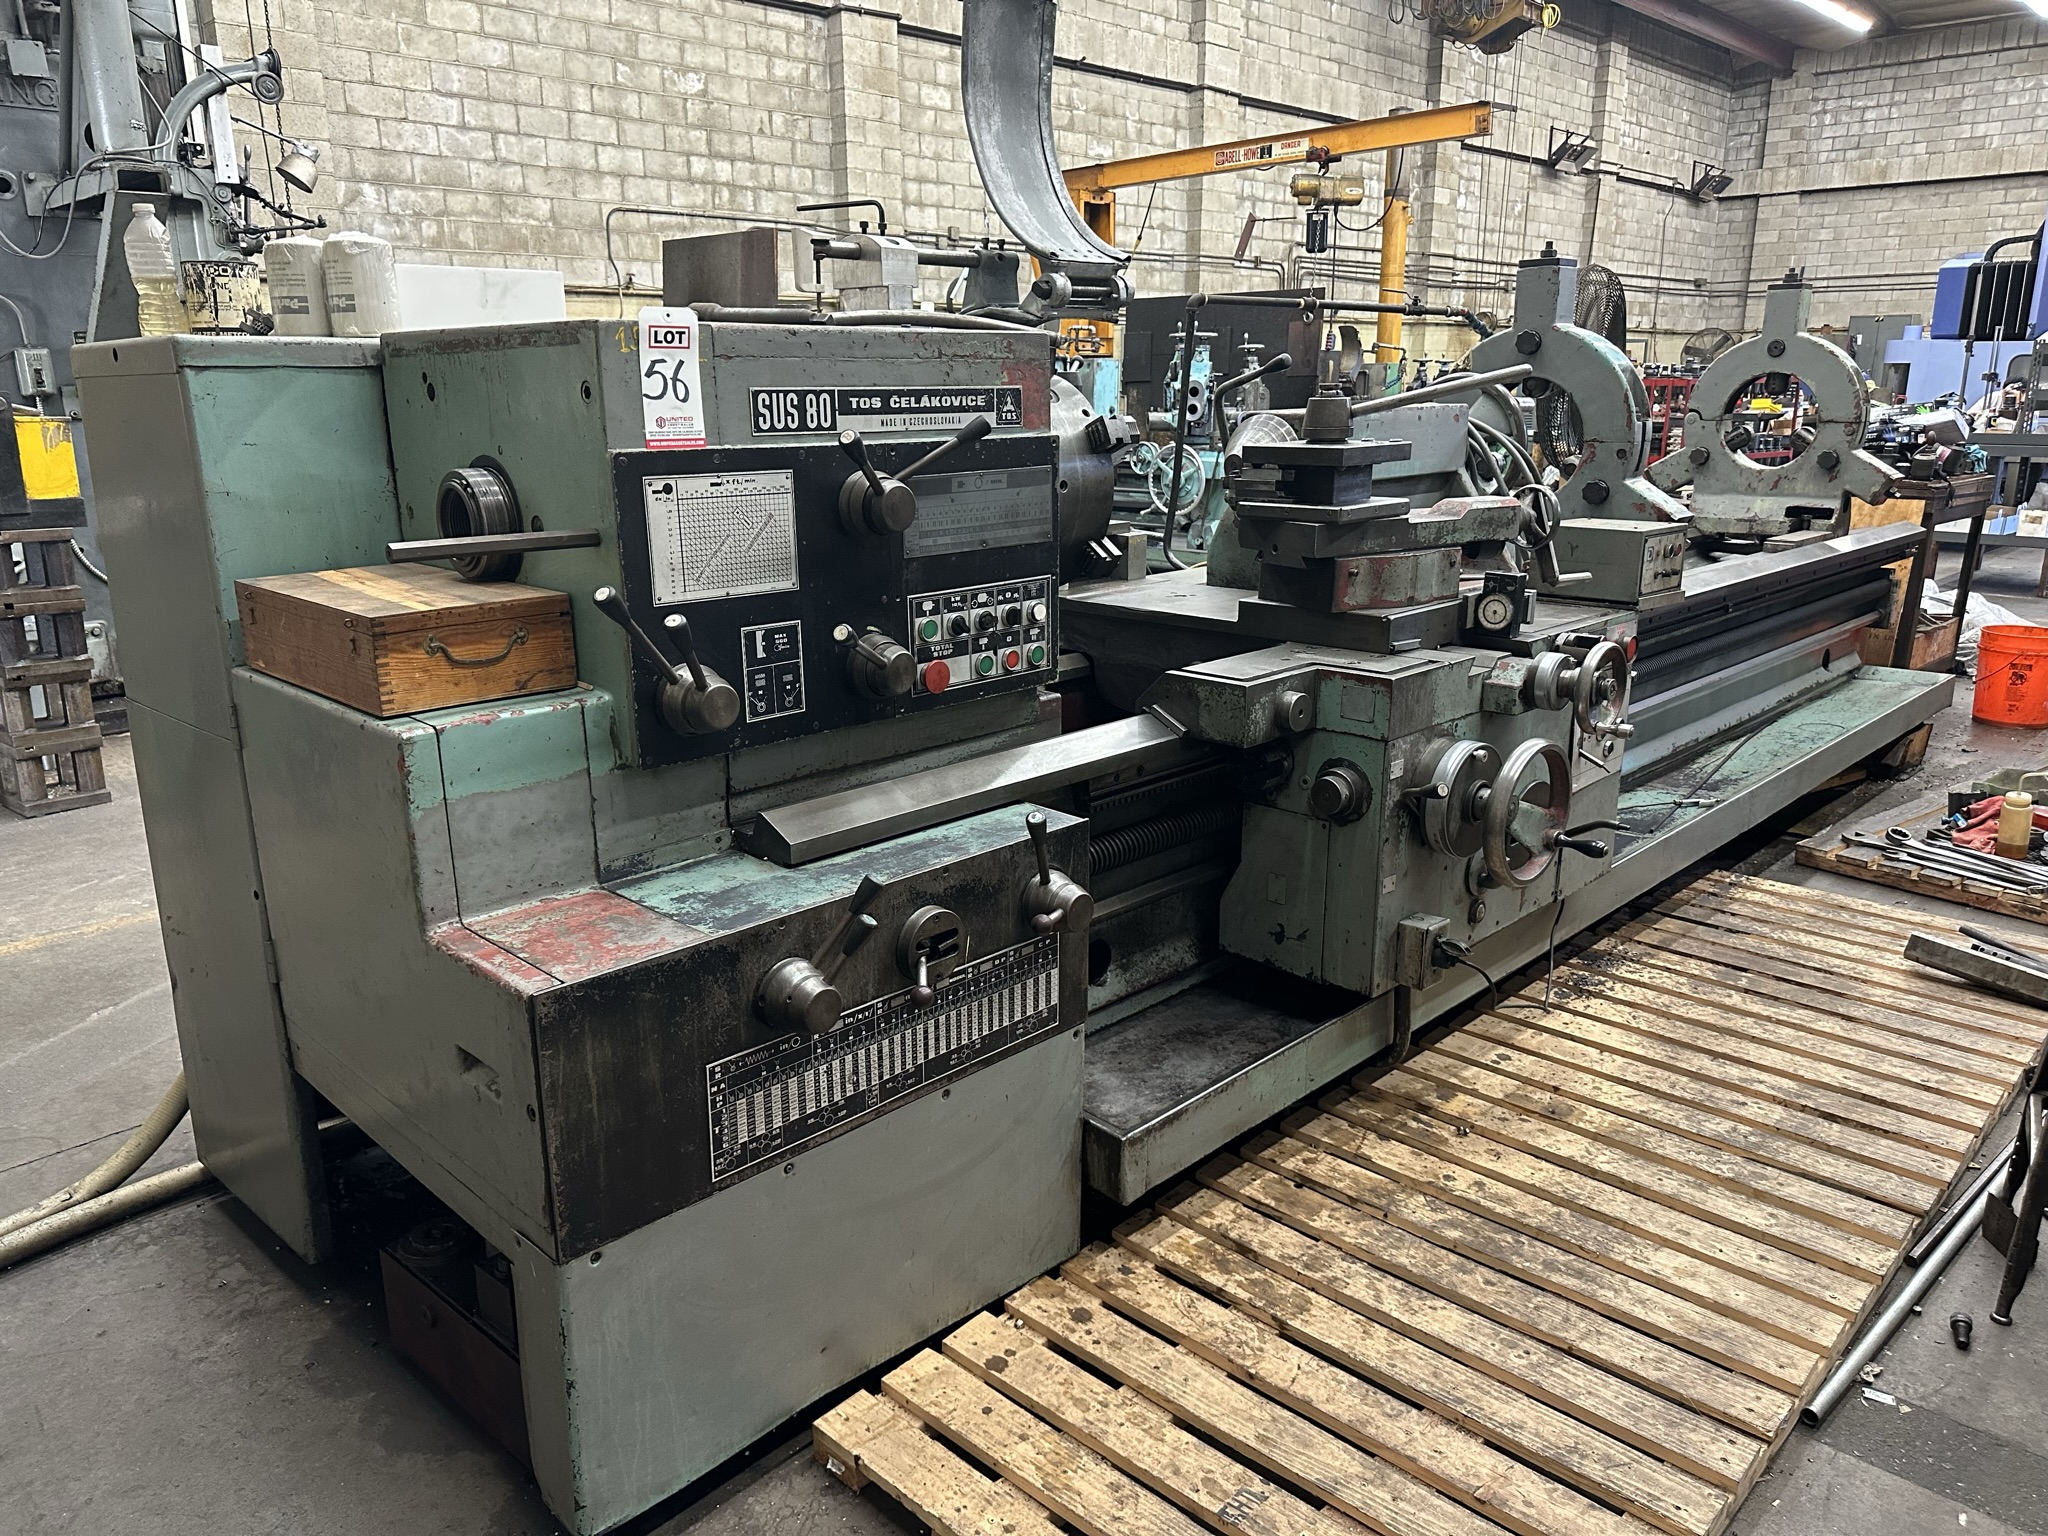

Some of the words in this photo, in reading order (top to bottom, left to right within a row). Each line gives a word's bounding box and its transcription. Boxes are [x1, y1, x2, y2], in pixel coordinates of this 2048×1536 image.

[653, 330, 686, 345] LOT
[642, 358, 690, 404] 56
[849, 397, 882, 409] TOS
[890, 393, 986, 409] ČELÁKOVICE
[757, 392, 799, 430] SUS
[805, 392, 832, 429] 80
[880, 418, 897, 427] MADE
[909, 416, 962, 426] CZECHOSLOVAKIA
[930, 643, 954, 652] TOTAL
[933, 649, 953, 658] STOP
